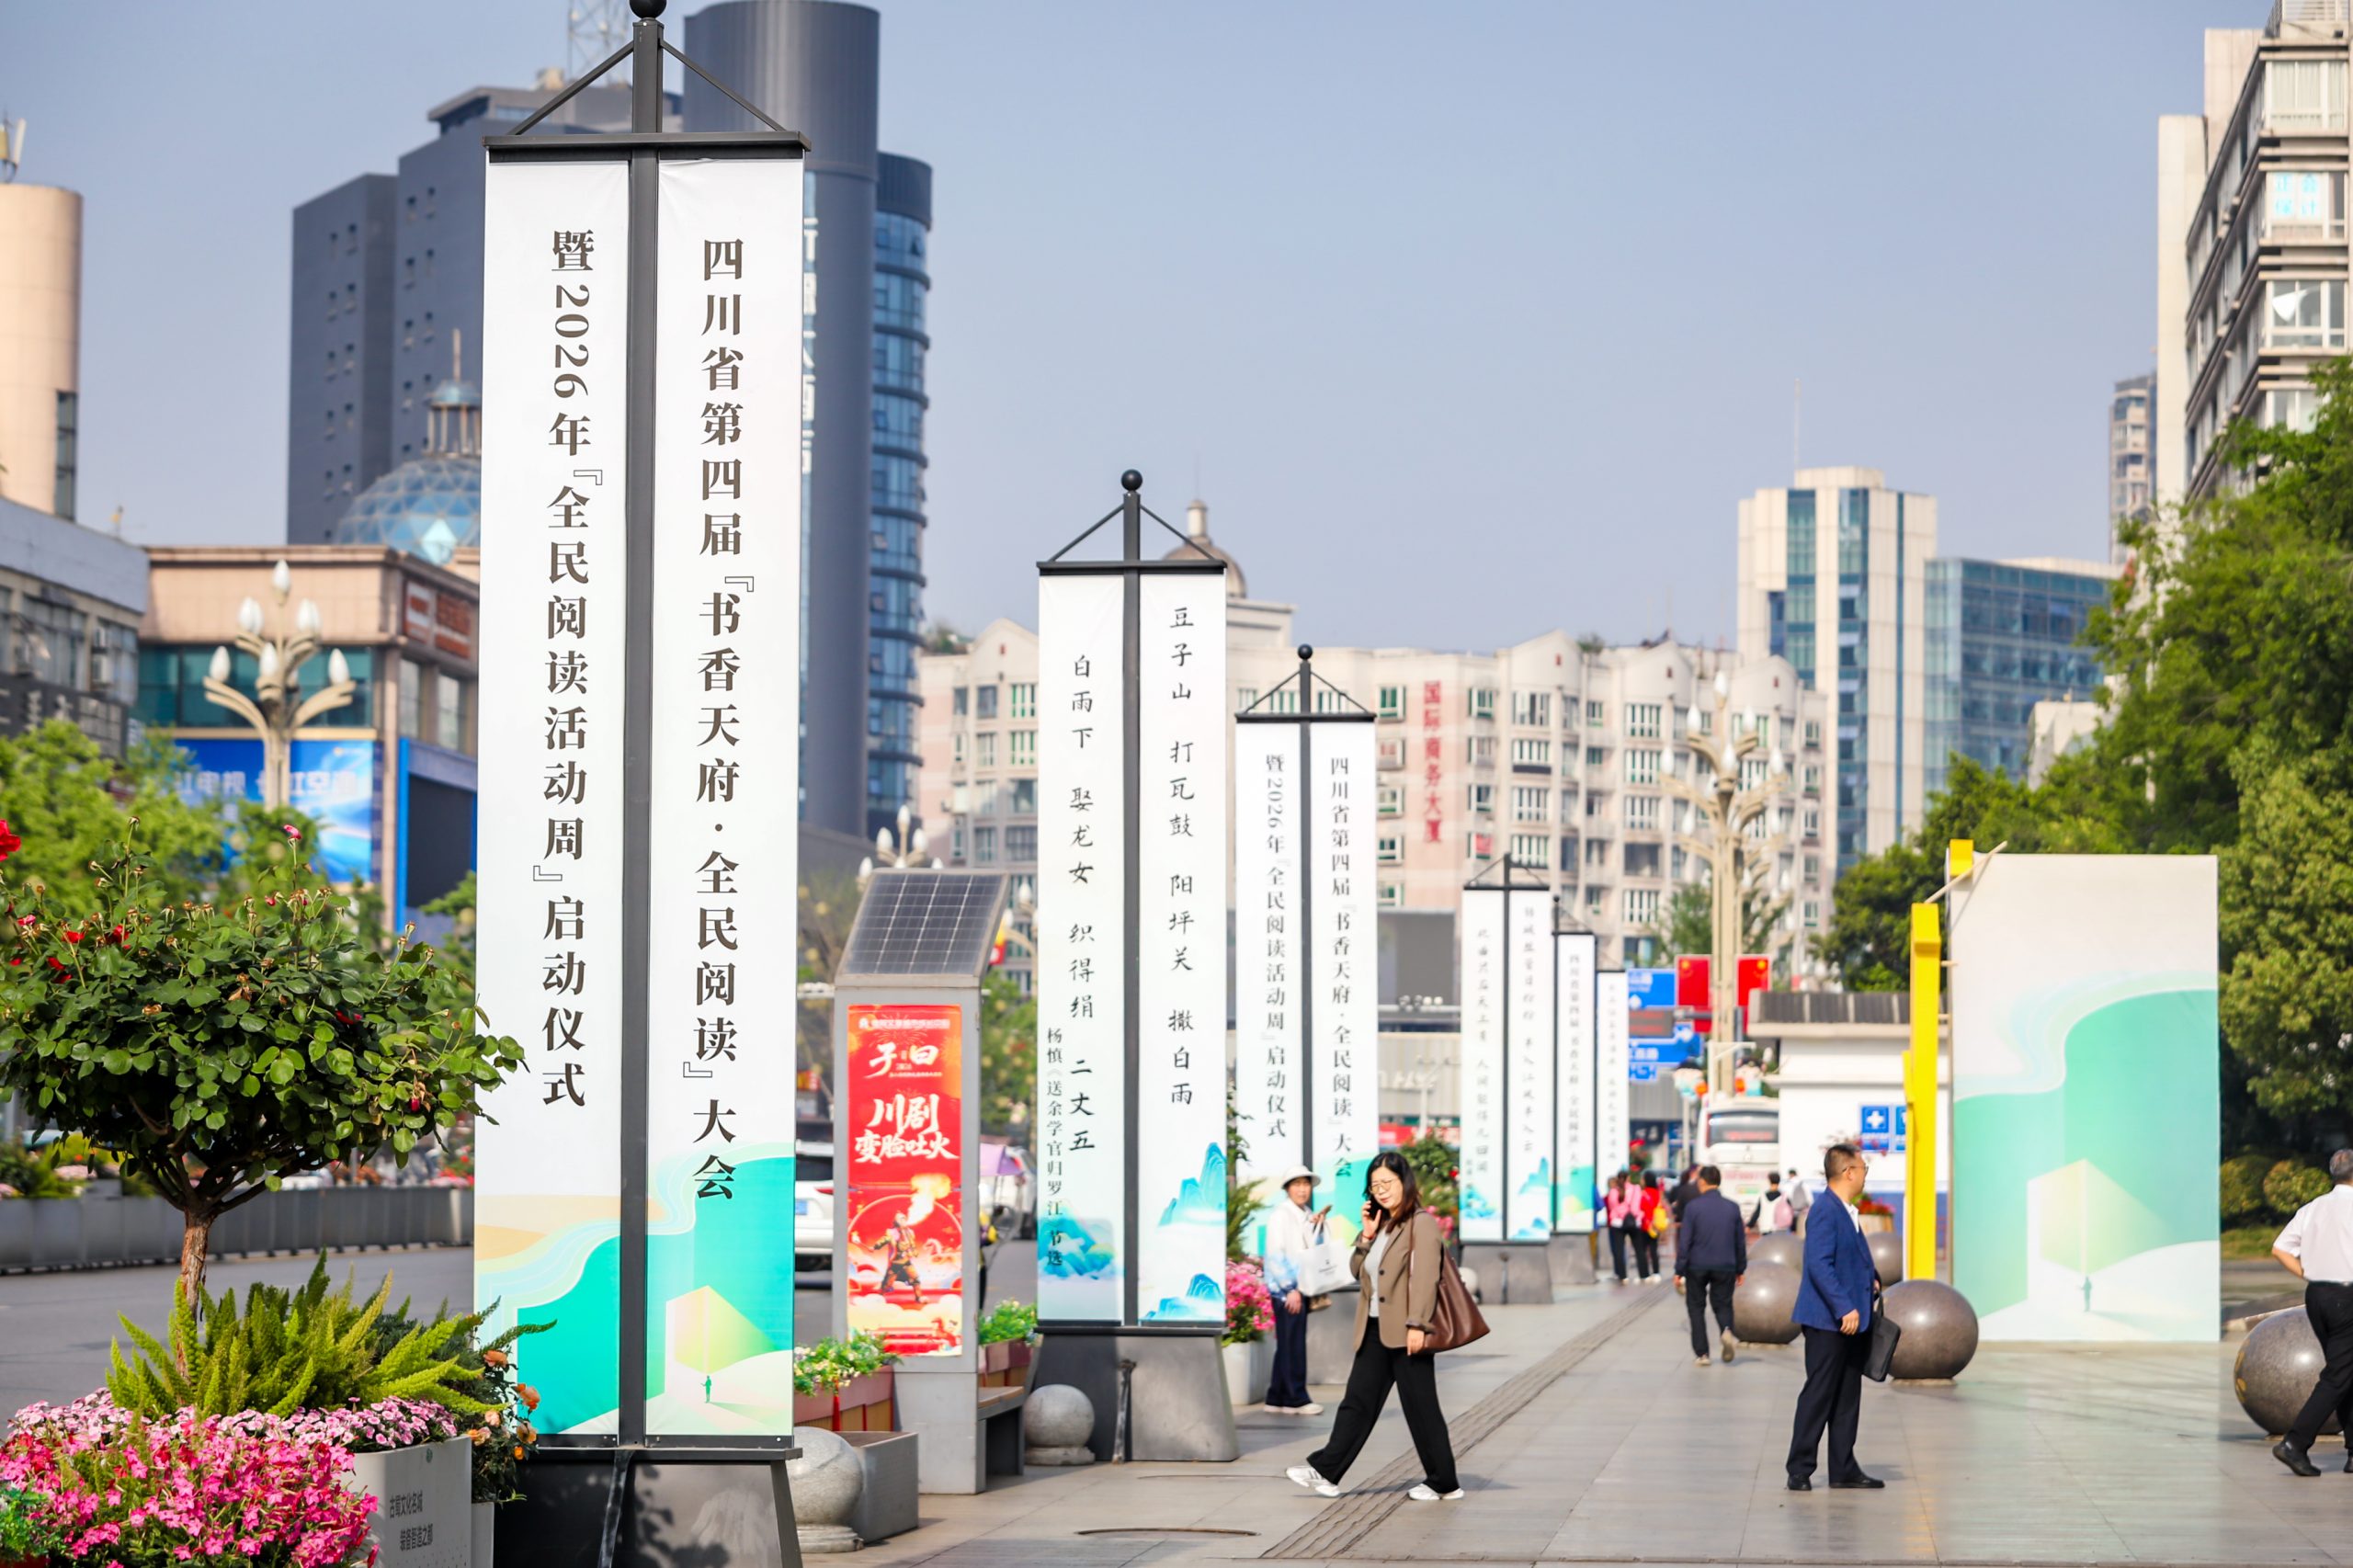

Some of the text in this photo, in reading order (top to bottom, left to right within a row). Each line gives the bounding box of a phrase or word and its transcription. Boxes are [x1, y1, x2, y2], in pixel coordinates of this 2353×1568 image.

[1169, 607, 1194, 699] 豆子山
[1169, 741, 1195, 837] 打瓦鼓
[1423, 680, 1442, 844] 国际商务大厦
[1069, 654, 1096, 1151] 白雨下 娶龙女 织得绢 二丈五
[1168, 1009, 1194, 1105] 撒白雨
[855, 1129, 960, 1164] 变脸吐火
[866, 1093, 940, 1136] 川剧
